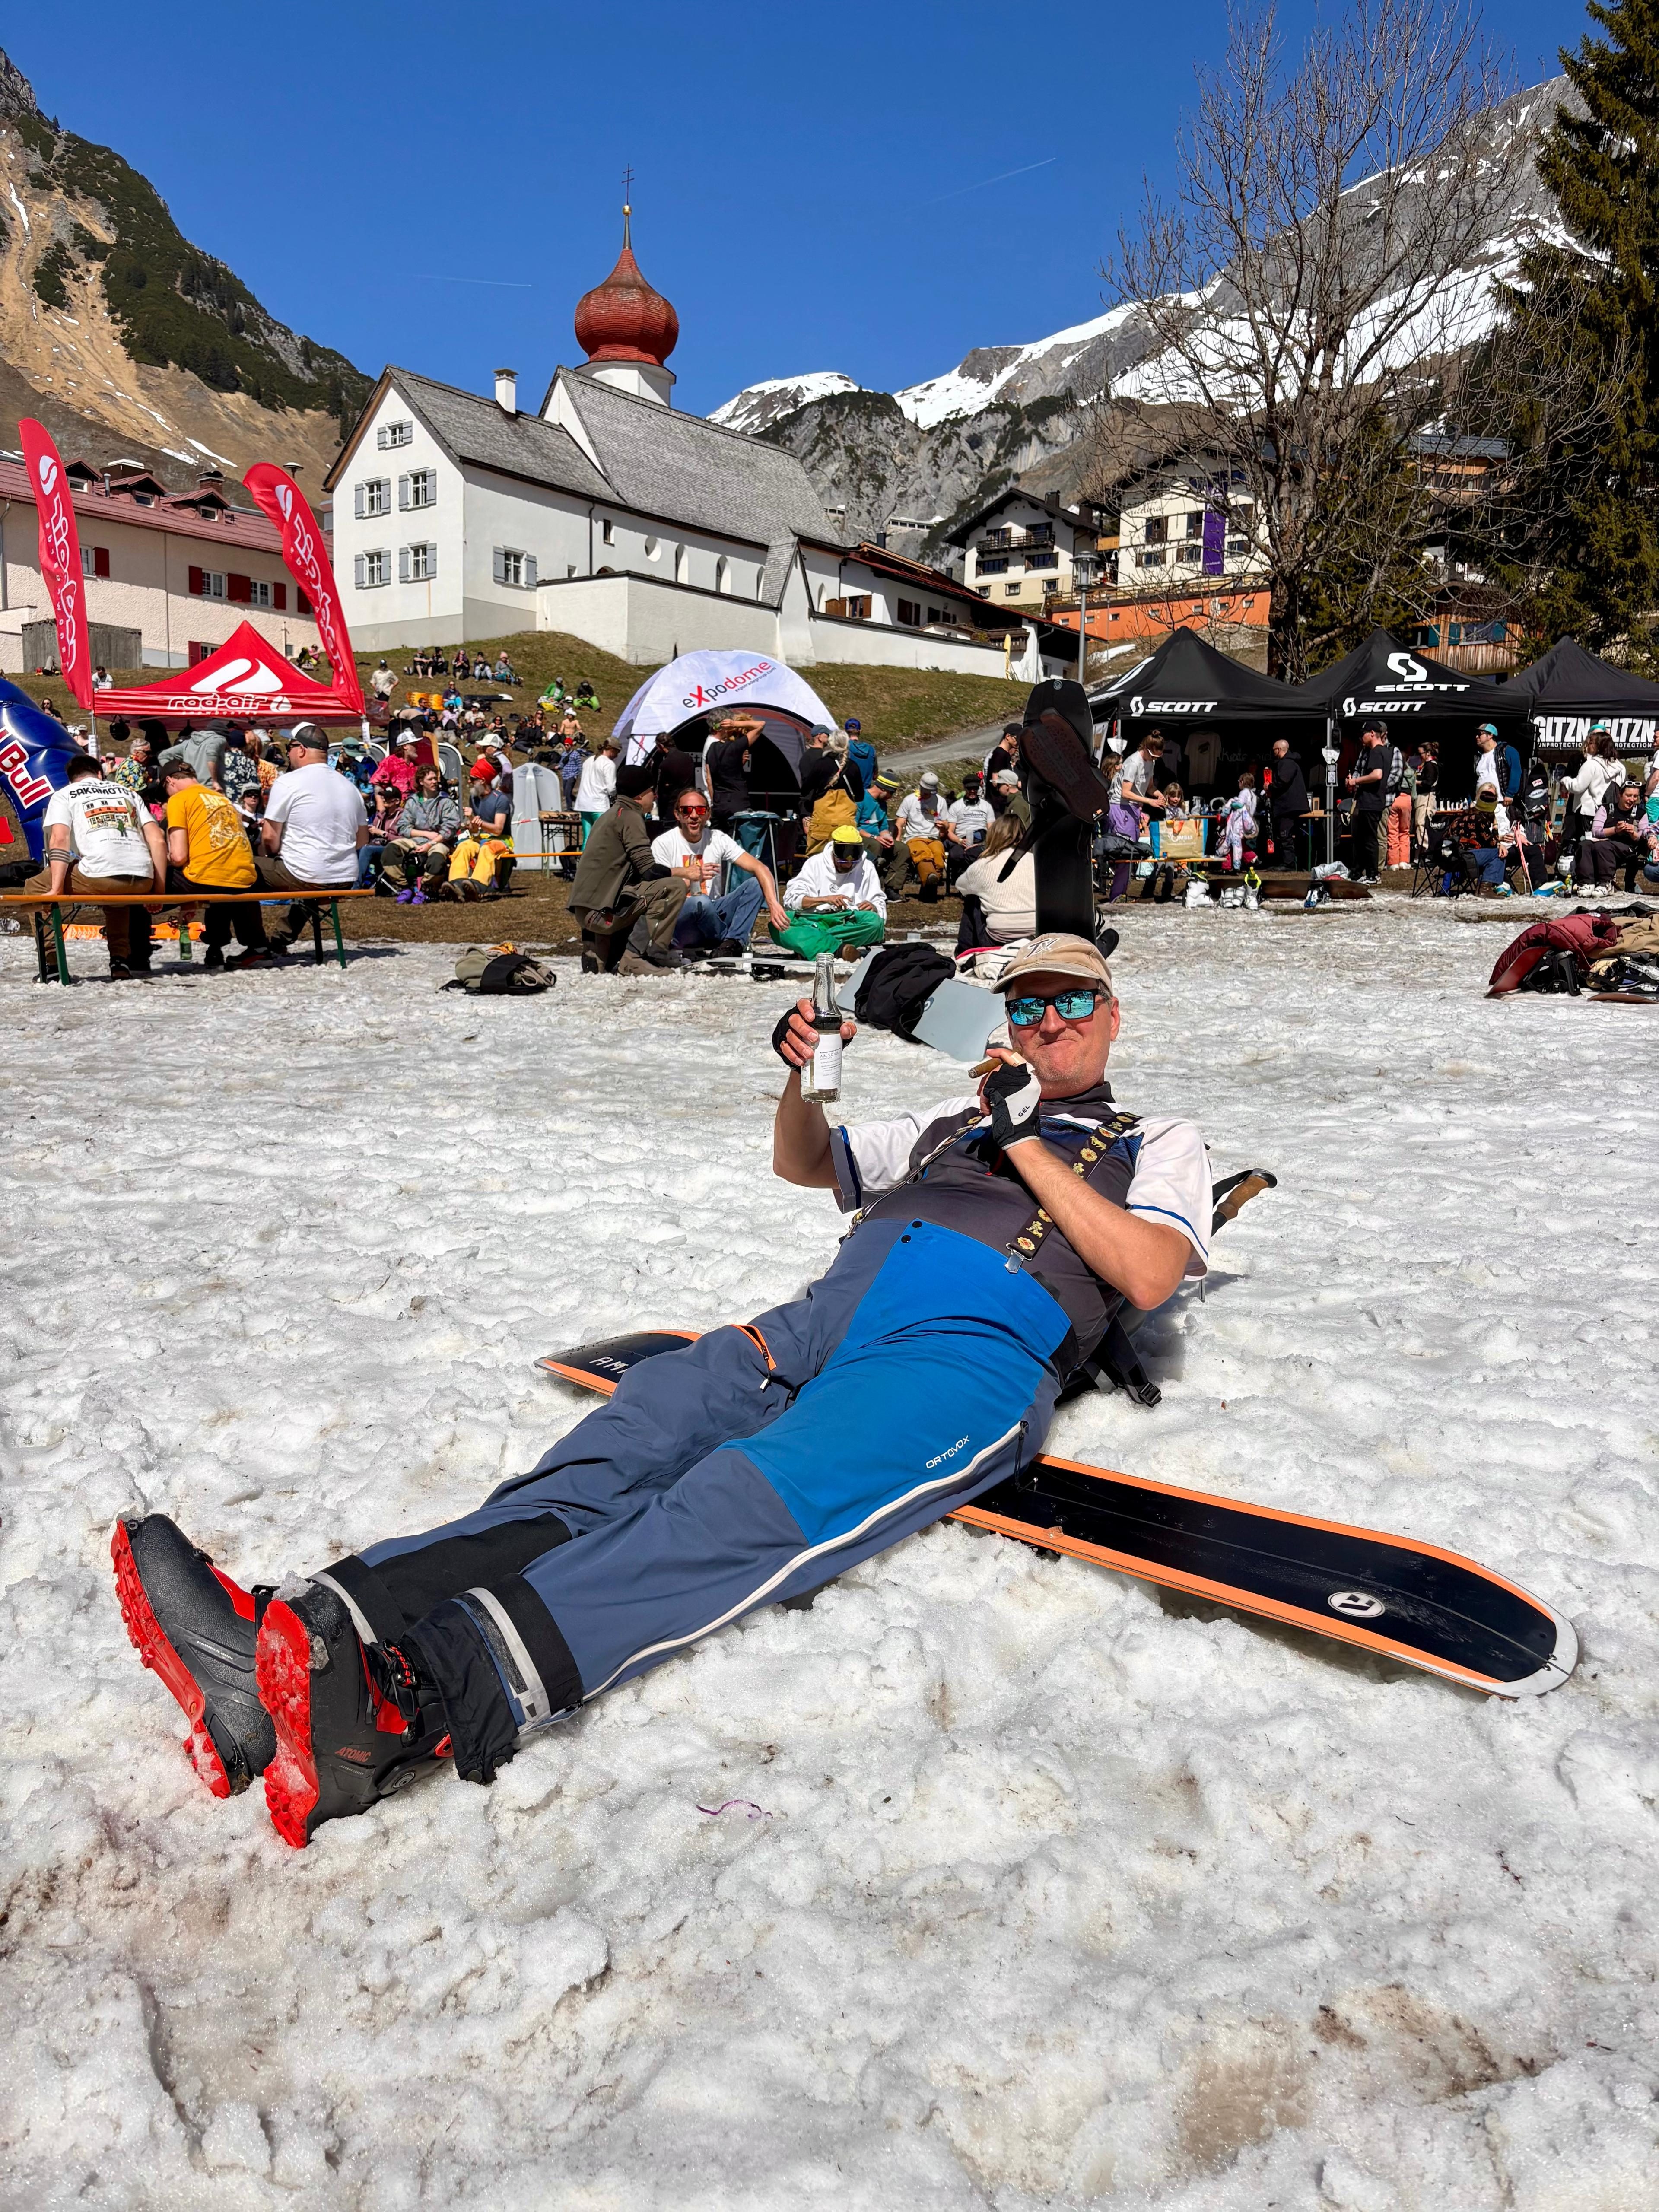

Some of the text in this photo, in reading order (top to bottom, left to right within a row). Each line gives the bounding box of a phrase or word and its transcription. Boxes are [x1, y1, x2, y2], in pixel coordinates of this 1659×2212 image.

[1374, 683, 1471, 692] SCOTT
[1145, 702, 1217, 712] SCOTT
[1357, 702, 1426, 712] SCOTT
[0, 740, 55, 809] Bull
[1018, 1106, 1030, 1117] GEL
[926, 1435, 970, 1469] ORTOVOX
[335, 1747, 371, 1763] ATOMIC
